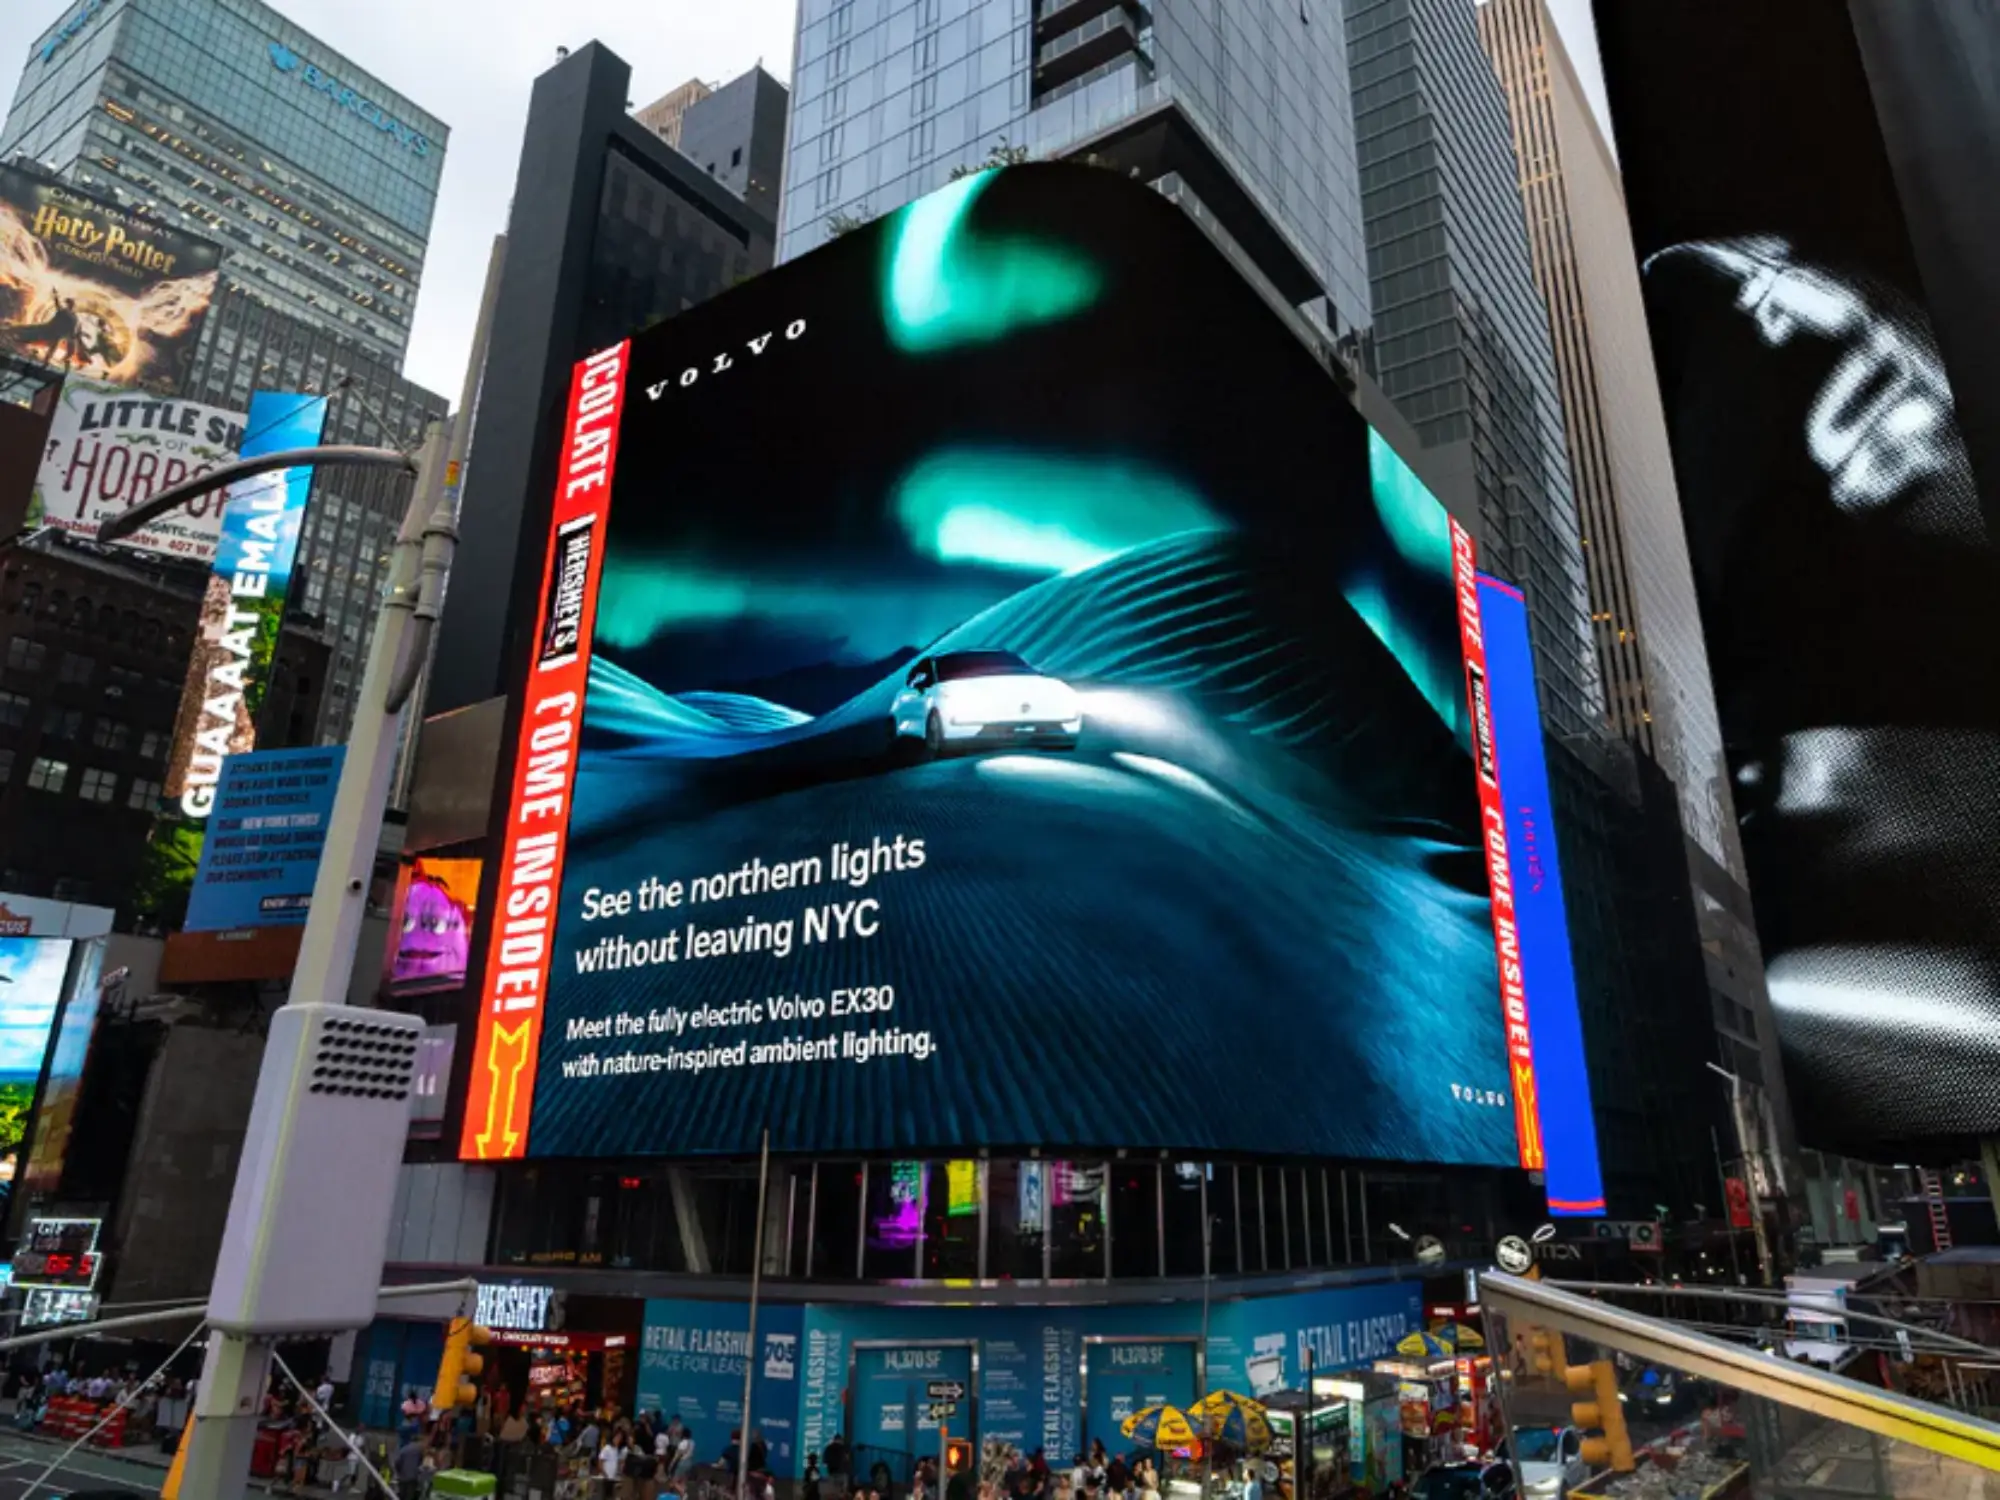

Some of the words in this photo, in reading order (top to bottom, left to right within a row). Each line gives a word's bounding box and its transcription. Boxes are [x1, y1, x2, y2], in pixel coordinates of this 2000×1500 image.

[303, 63, 428, 155] BARCLAYS
[31, 204, 104, 248] Harry
[105, 224, 176, 275] Potter
[645, 319, 806, 401] VOLVO
[80, 401, 199, 437] LITTLE
[42, 515, 99, 535] Westsid
[520, 691, 577, 824] COME
[581, 888, 630, 921] See
[638, 877, 683, 912] the
[691, 857, 822, 903] northern
[831, 834, 927, 887] lights
[493, 831, 558, 1014] INSIDE!
[575, 930, 678, 973] without
[685, 916, 794, 957] leaving
[803, 899, 880, 945] NYC
[1485, 806, 1512, 914] COME
[1499, 917, 1531, 1058] INSIDE!
[566, 1018, 611, 1041] Meet
[615, 1013, 644, 1036] the
[648, 1009, 687, 1037] fully
[690, 1000, 763, 1028] electric
[767, 995, 825, 1022] Volvo
[831, 984, 895, 1016] EX30
[562, 1054, 599, 1078] with
[602, 1040, 746, 1079] nature-inspired
[749, 1035, 837, 1065] ambient
[842, 1027, 937, 1062] lighting.
[643, 1352, 680, 1372] SPACE
[683, 1354, 709, 1373] FOR
[645, 1325, 686, 1352] RETAIL
[807, 1329, 828, 1408] FLAGSHIP
[1043, 1326, 1060, 1402] FLAGSHIP
[1043, 1406, 1060, 1461] RETAIL
